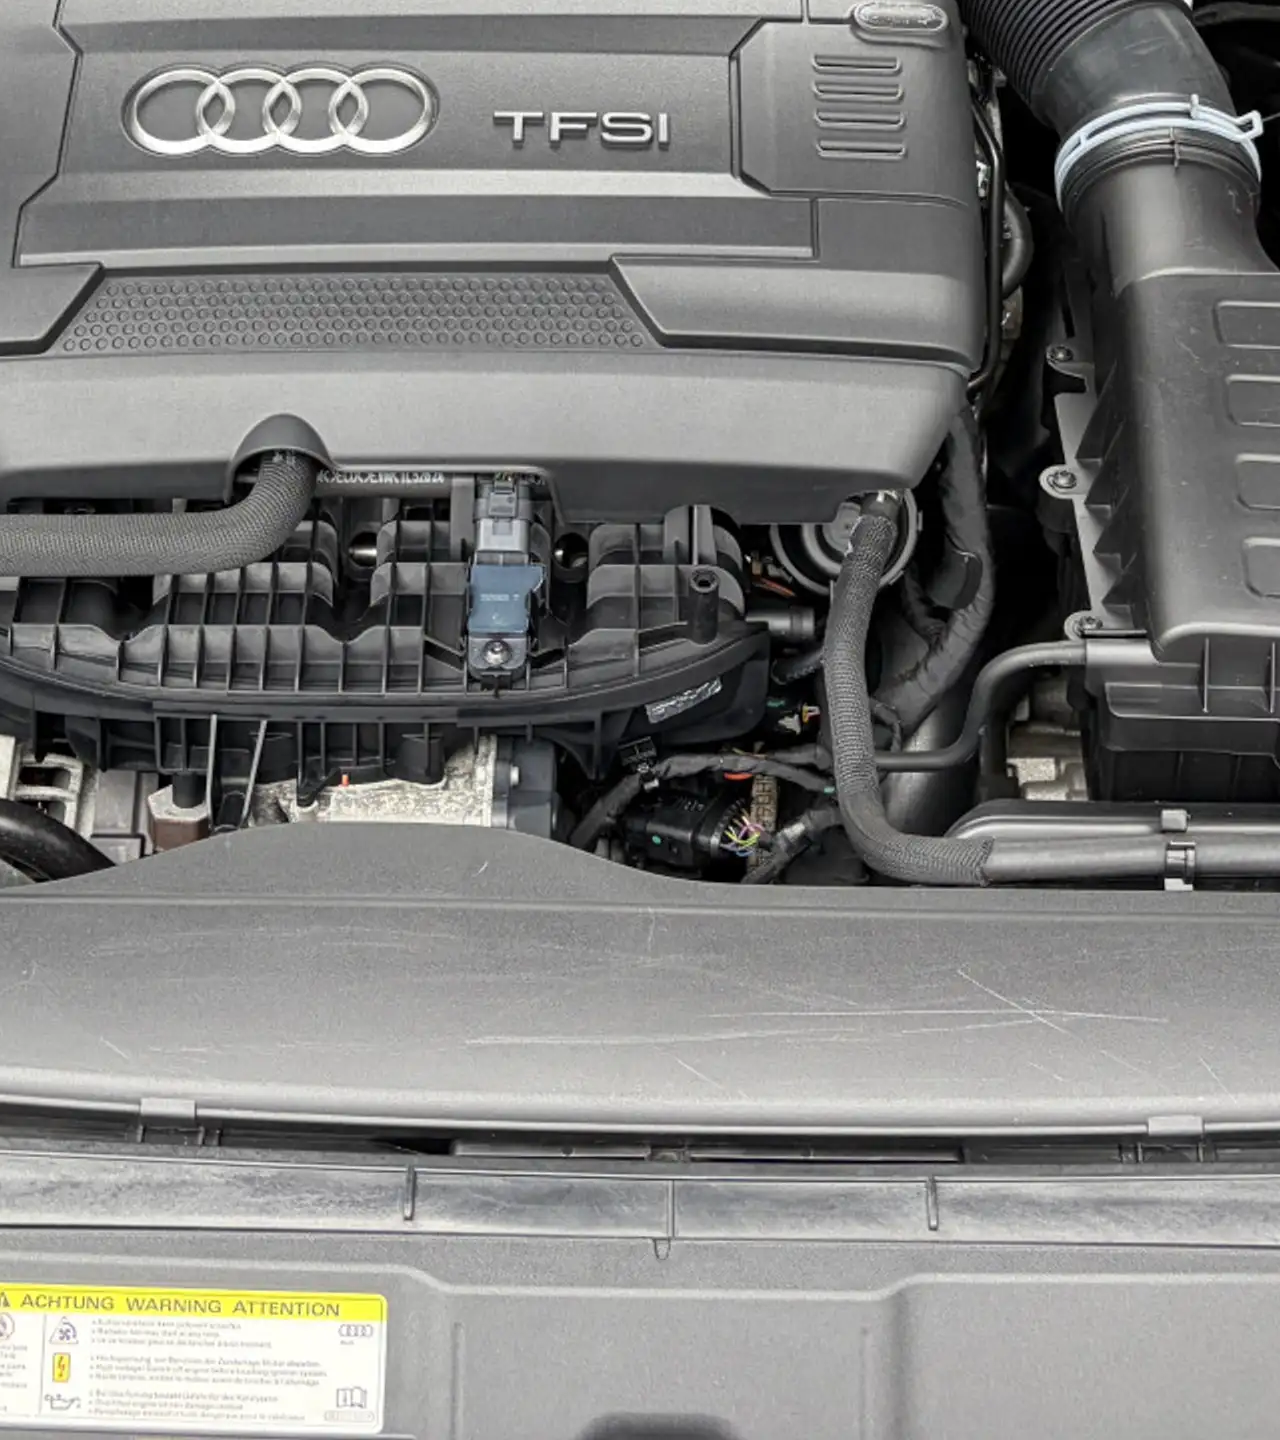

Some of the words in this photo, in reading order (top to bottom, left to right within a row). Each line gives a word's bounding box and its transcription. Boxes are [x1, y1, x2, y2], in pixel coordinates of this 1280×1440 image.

[493, 110, 672, 148] TFSI
[20, 1293, 115, 1311] ACHTUNG
[126, 1296, 222, 1315] WARNING
[232, 1300, 341, 1318] ATTENTION
